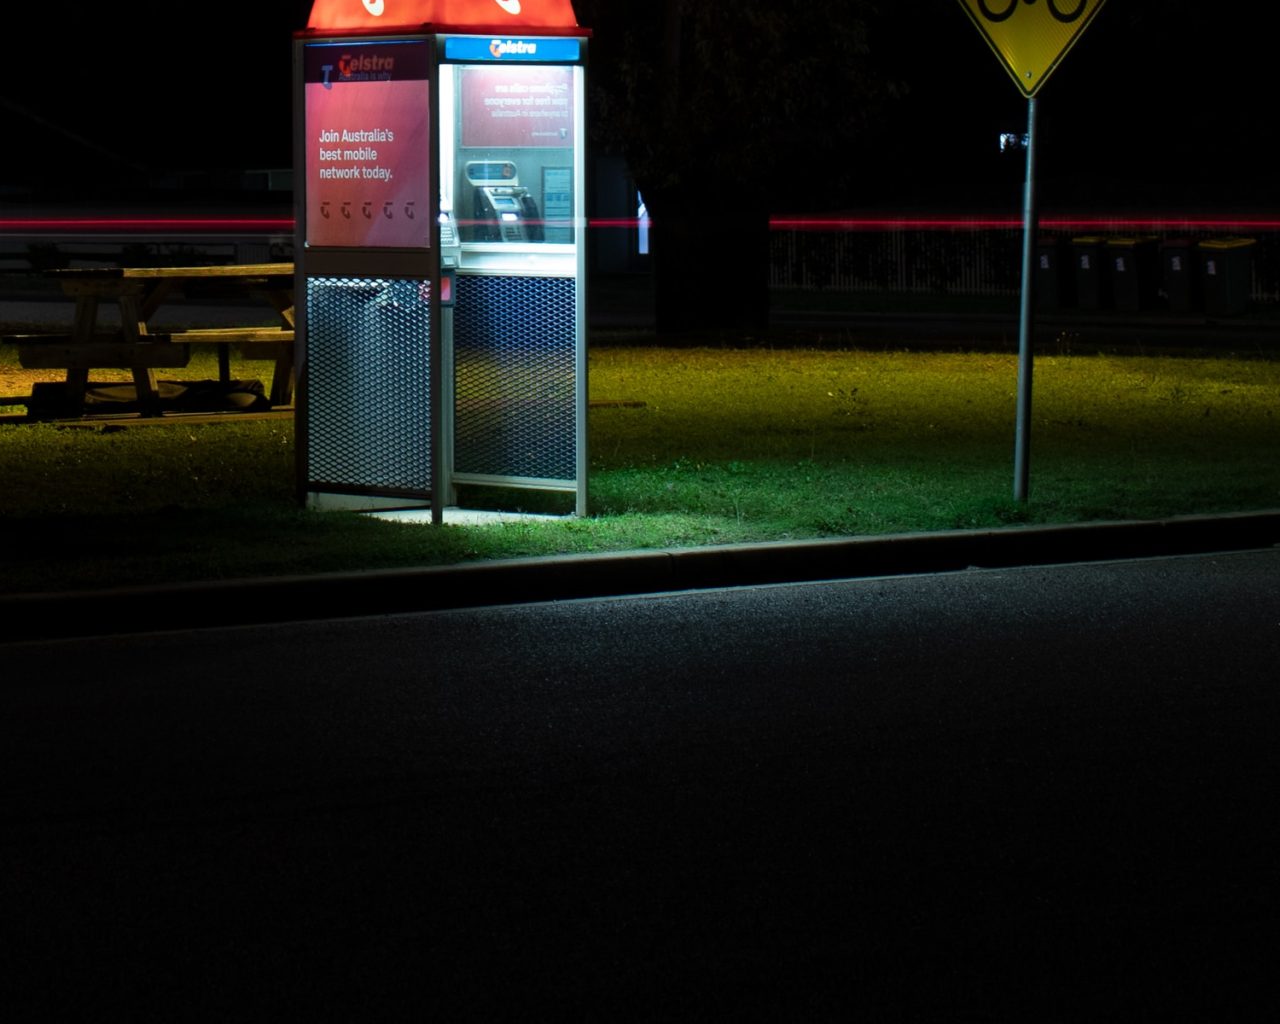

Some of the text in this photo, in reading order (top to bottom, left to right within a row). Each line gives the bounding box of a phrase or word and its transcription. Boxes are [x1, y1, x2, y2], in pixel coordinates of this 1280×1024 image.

[489, 39, 537, 58] Telstra
[338, 54, 394, 76] Telstra
[319, 128, 394, 142] Join Australia's
[320, 147, 377, 161] best mobile
[320, 165, 393, 182] network today.
